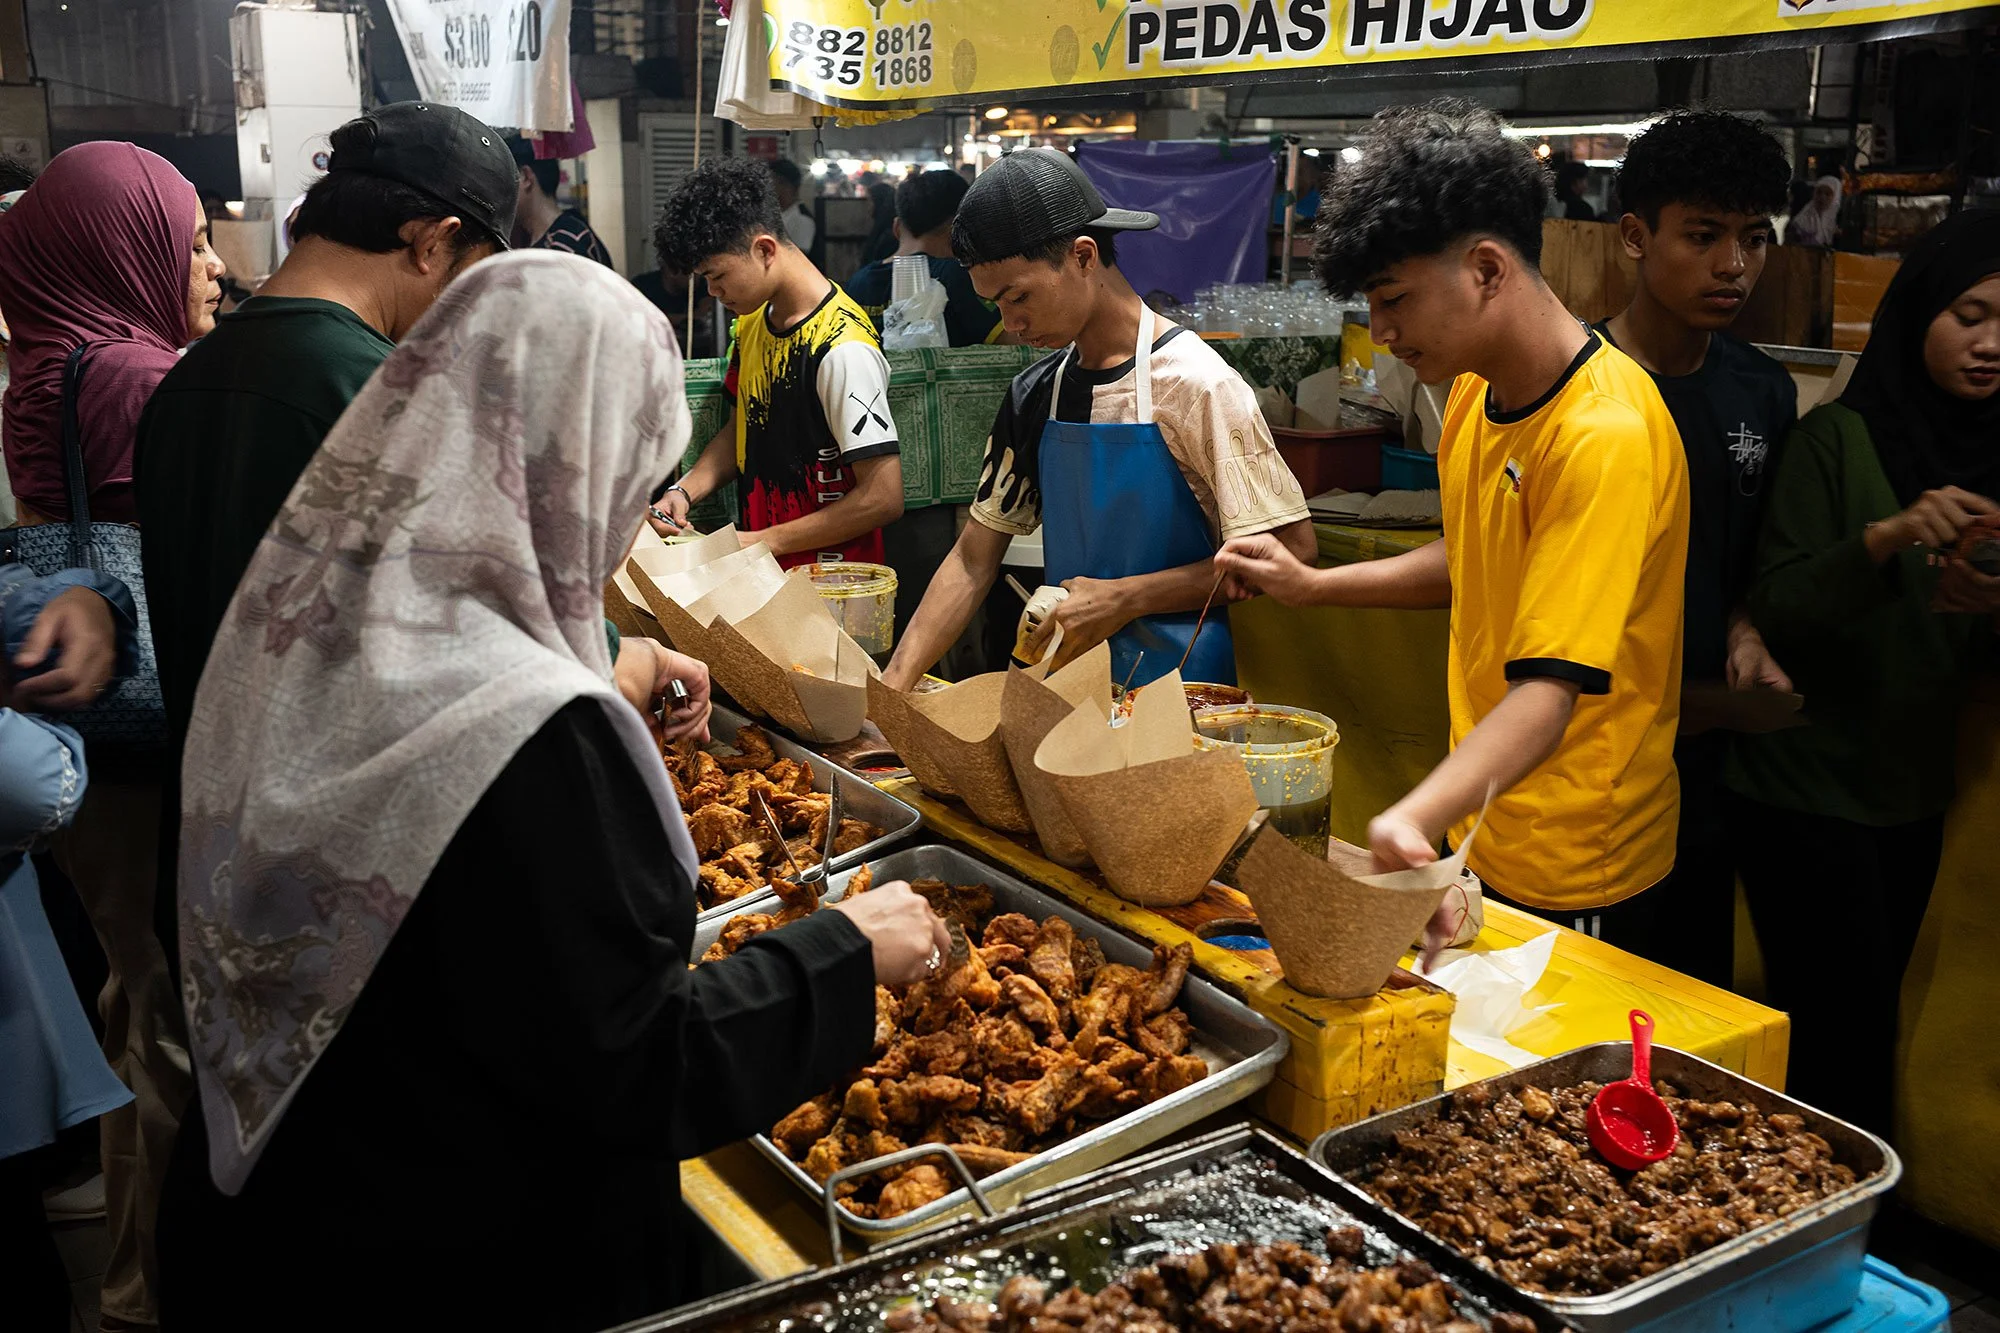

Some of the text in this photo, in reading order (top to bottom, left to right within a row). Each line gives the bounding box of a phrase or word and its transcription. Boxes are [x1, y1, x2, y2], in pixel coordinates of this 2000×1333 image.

[788, 21, 932, 56] 882 8812
[1128, 0, 1326, 64] PEDAS
[785, 44, 862, 85] 735
[874, 55, 932, 86] 1868
